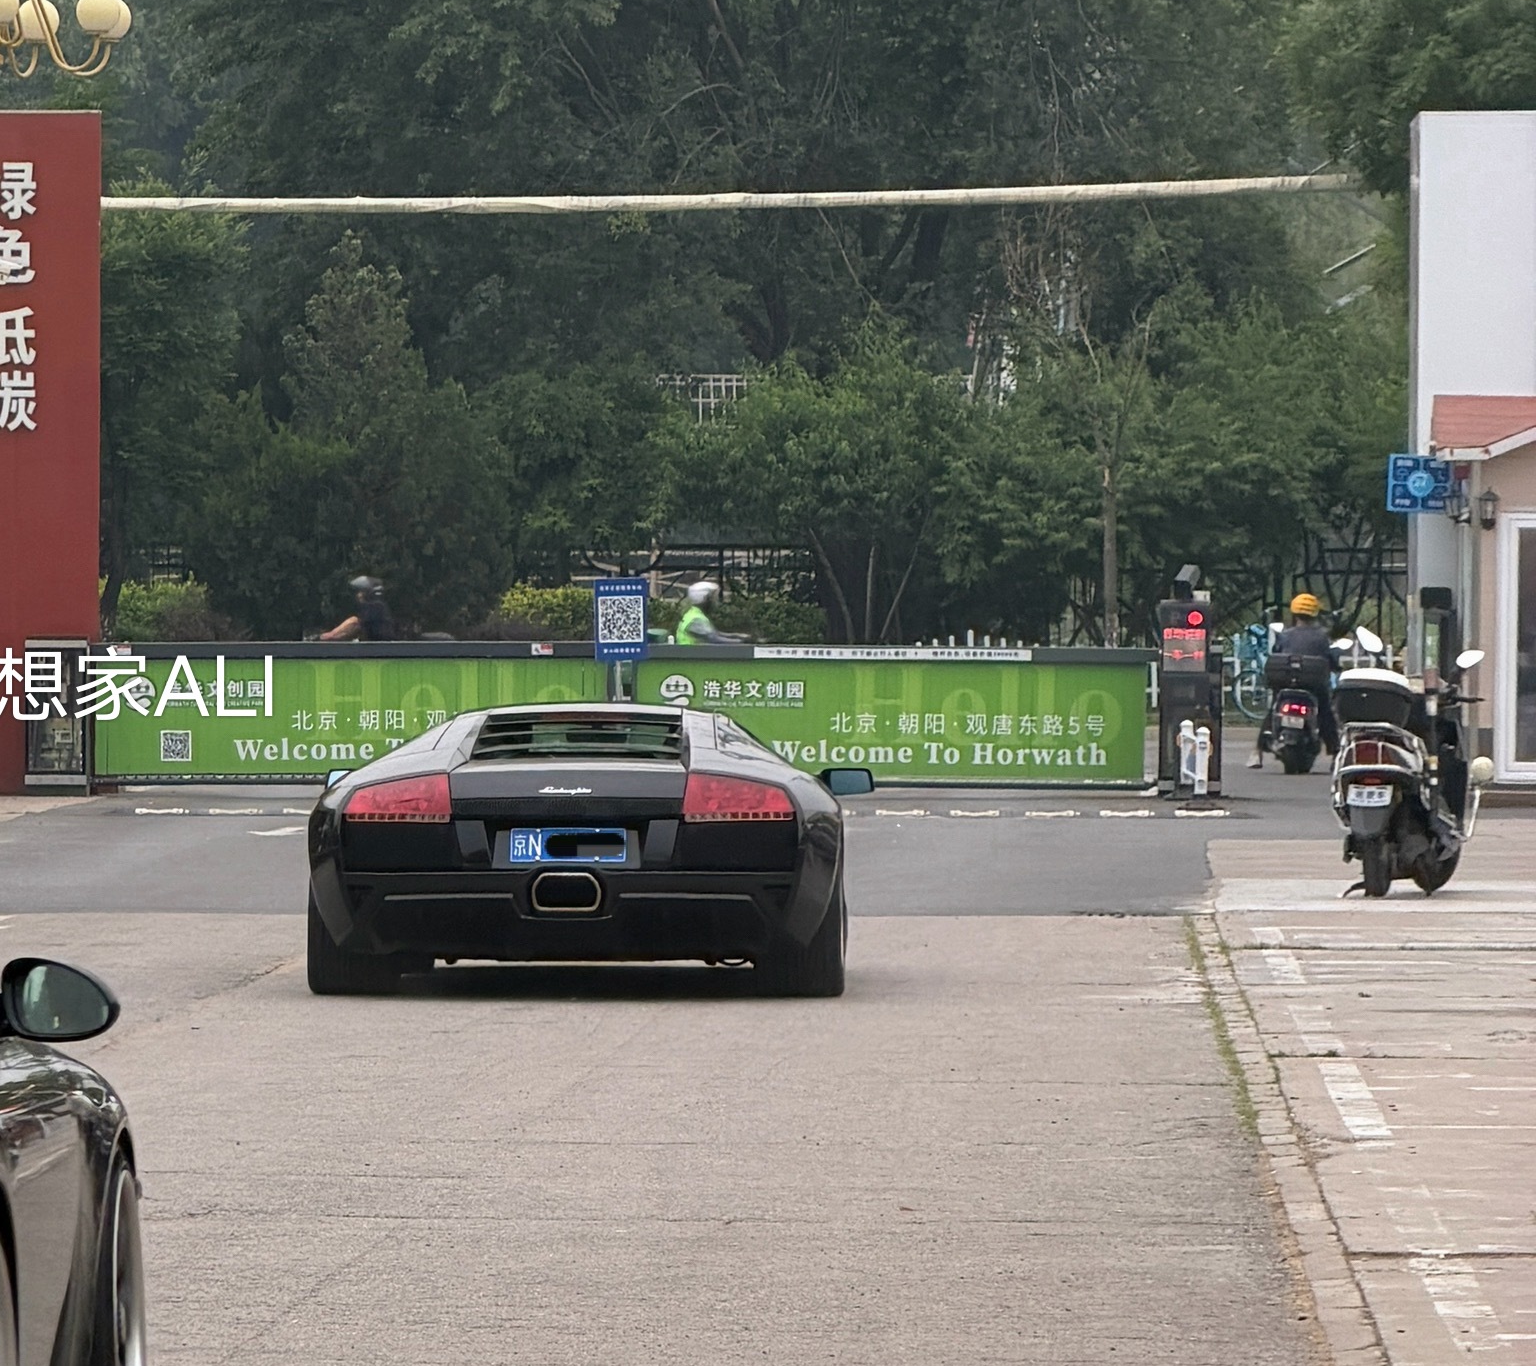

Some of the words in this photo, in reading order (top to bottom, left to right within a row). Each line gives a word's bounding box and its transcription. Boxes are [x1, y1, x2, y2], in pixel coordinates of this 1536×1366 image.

[703, 680, 804, 699] 浩华文创园
[291, 709, 448, 731] 北京·朝阳·观
[233, 738, 375, 761] Welcome
[772, 739, 913, 764] Welcome
[924, 742, 961, 765] To
[972, 741, 1107, 766] Horwath
